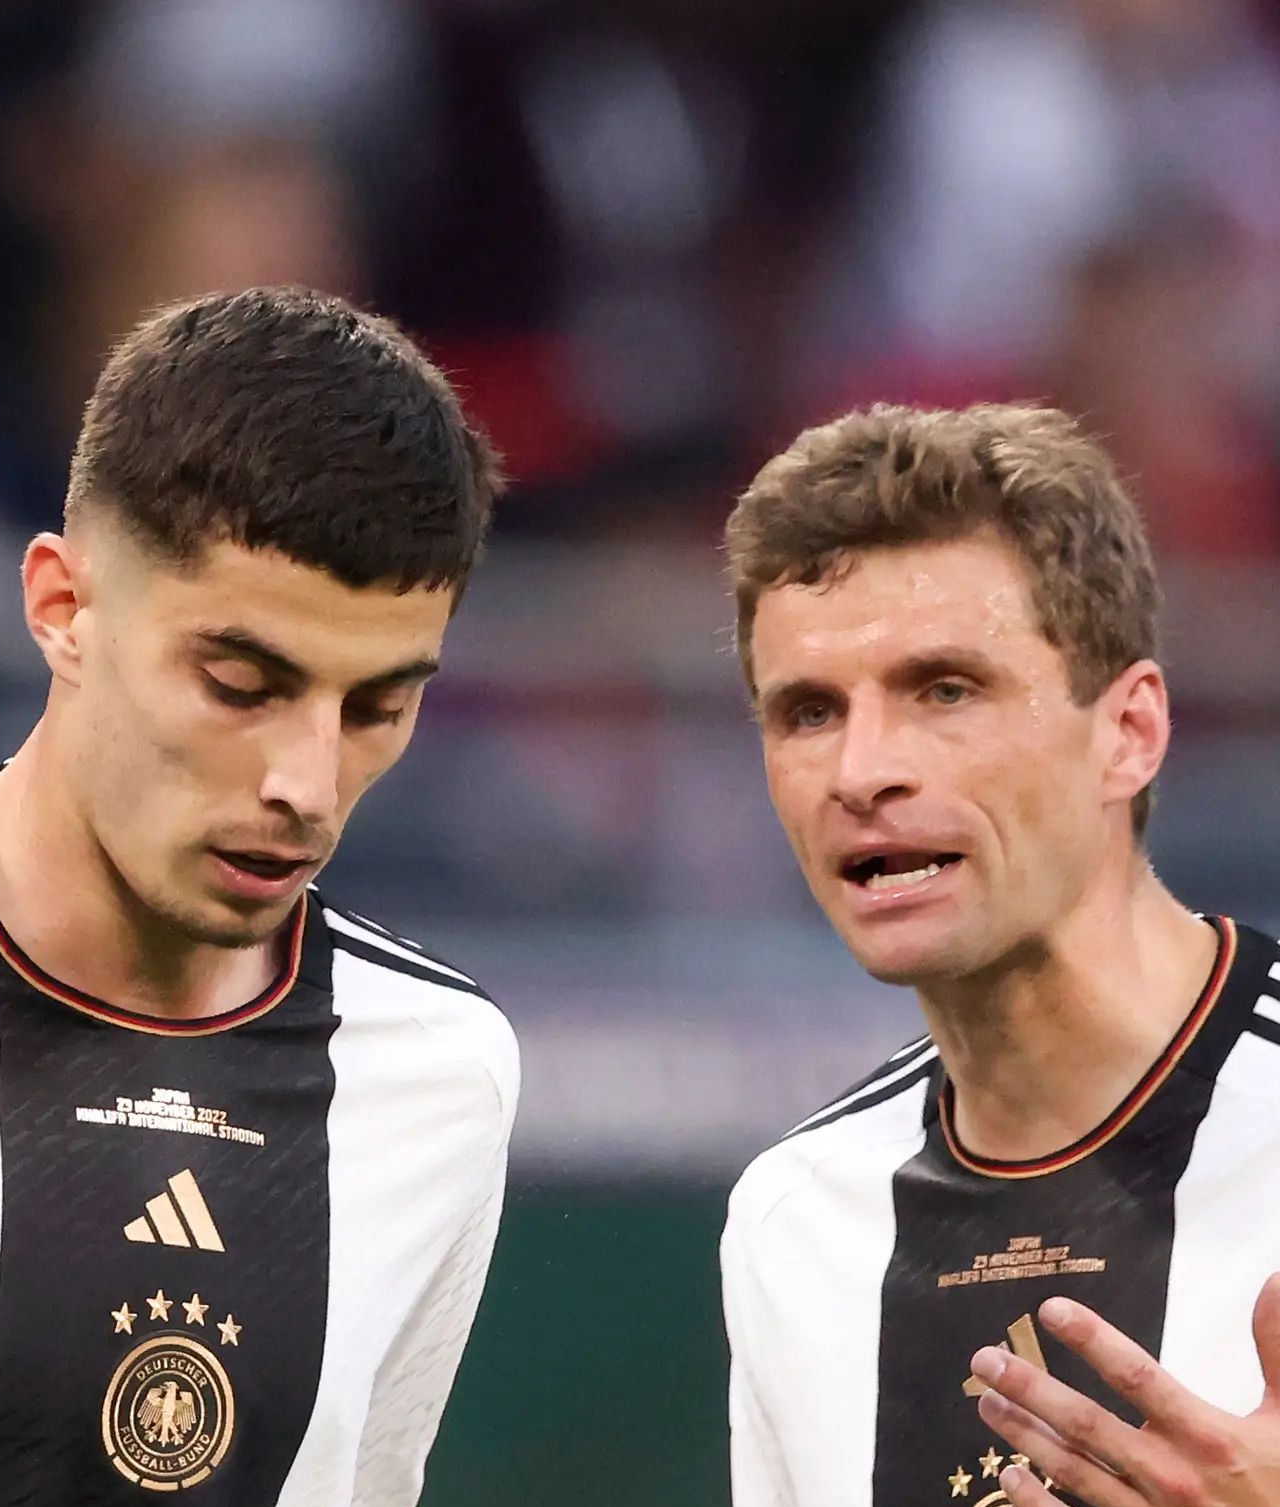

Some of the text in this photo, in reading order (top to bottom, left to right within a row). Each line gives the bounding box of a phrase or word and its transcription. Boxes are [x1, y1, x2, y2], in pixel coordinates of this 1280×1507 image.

[116, 1097, 228, 1125] 23 NOVEMBER 2022
[128, 1112, 218, 1137] INTERNATIONAL
[219, 1125, 265, 1146] STADIUM
[136, 1357, 208, 1388] DEUTSCHER
[120, 1425, 210, 1470] FUSSBALL-BUND
